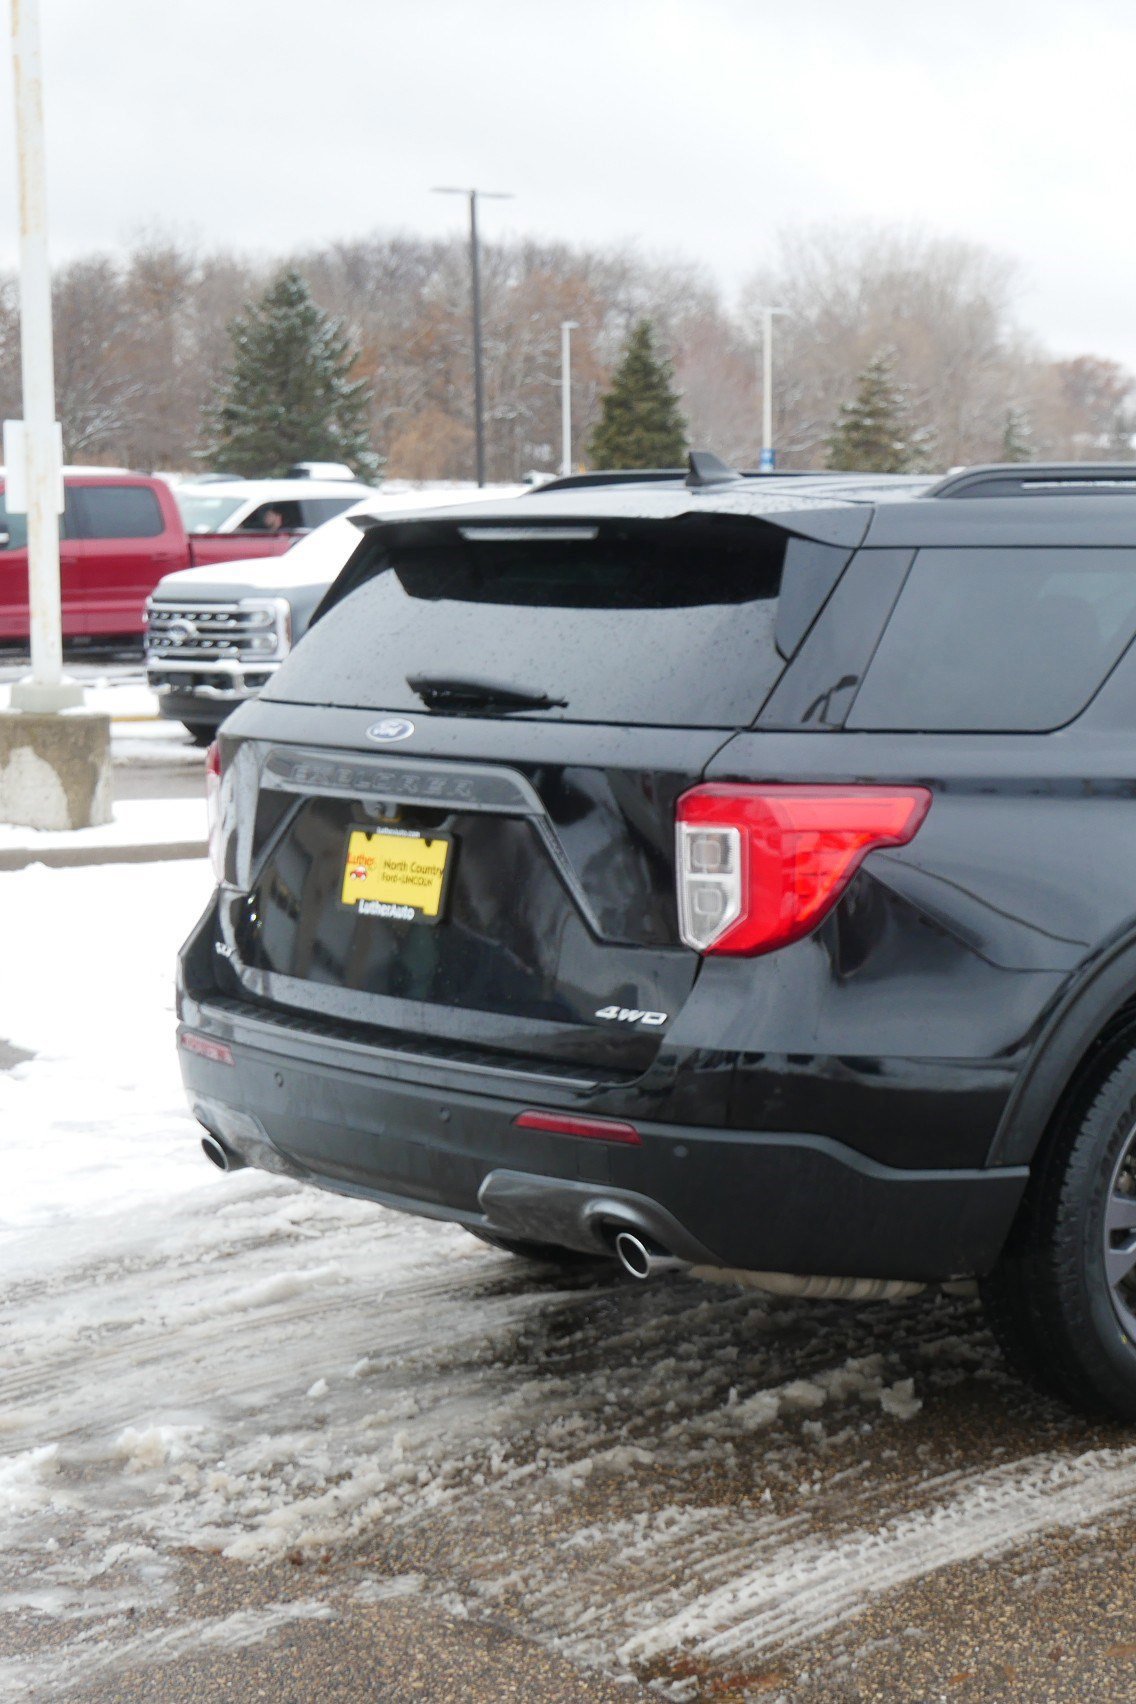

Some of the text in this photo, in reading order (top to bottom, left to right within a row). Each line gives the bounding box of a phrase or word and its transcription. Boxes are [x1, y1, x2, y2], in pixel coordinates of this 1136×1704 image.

[384, 858, 444, 878] North Country
[595, 1005, 668, 1026] 4WD
